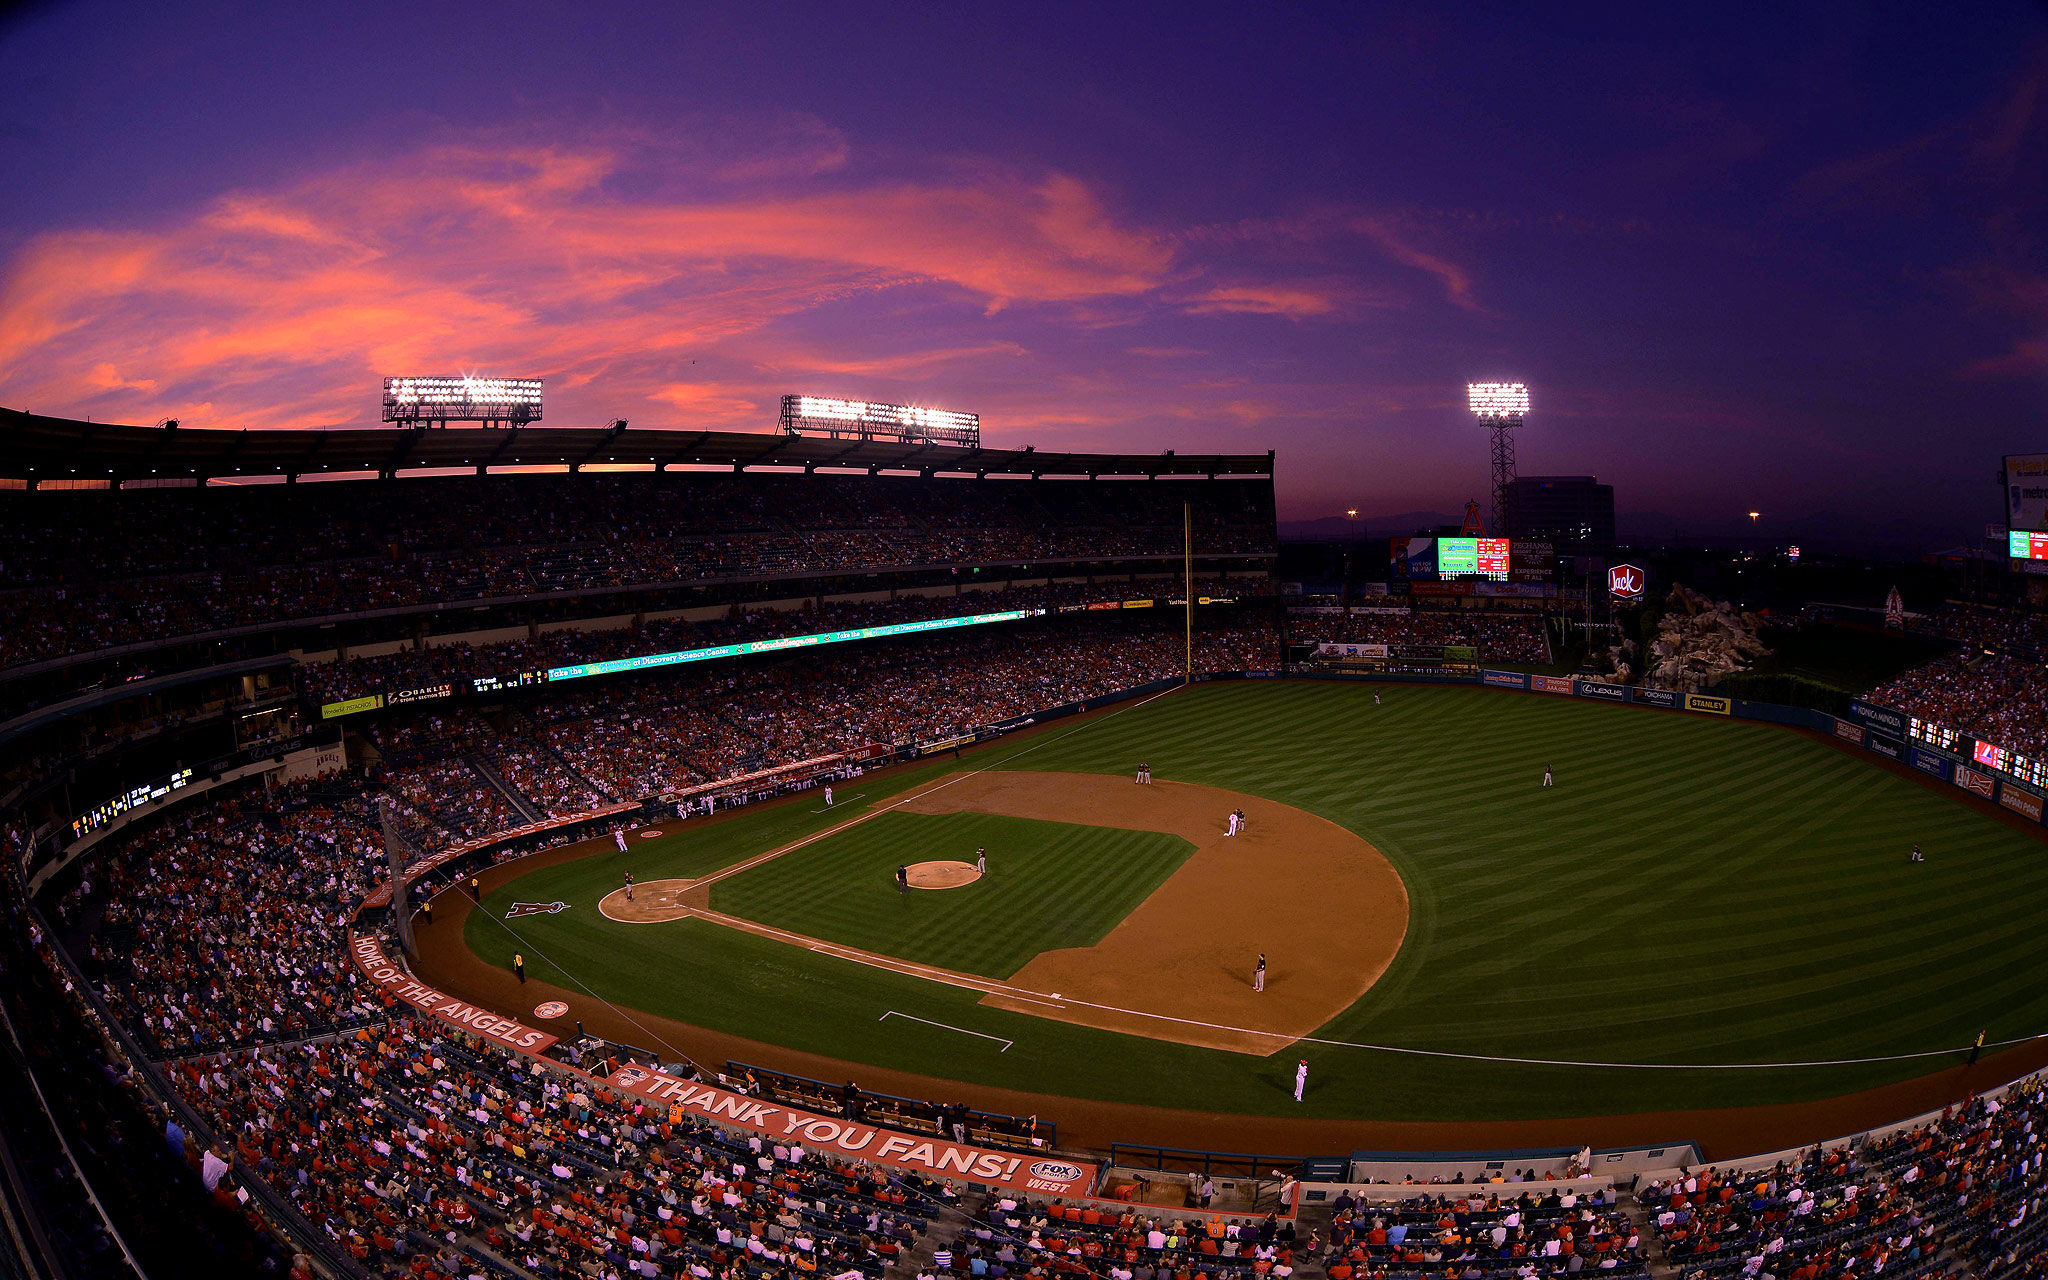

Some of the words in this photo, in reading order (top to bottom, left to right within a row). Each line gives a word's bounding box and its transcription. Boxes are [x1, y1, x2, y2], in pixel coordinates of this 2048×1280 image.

[1513, 542, 1553, 550] PECHANGA
[1611, 568, 1643, 593] Jack
[836, 631, 850, 639] Take
[851, 630, 860, 638] the
[901, 623, 924, 632] Discovery
[925, 621, 942, 629] Science
[943, 619, 959, 627] Center
[549, 669, 568, 679] Take
[571, 667, 583, 676] the
[642, 655, 677, 667] Discovery
[678, 651, 706, 661] Science
[706, 647, 730, 657] Center
[413, 684, 450, 695] OAKLEY
[418, 692, 437, 701] SECTION
[438, 689, 450, 698] 113
[1547, 685, 1569, 693] AAA.com
[1593, 686, 1623, 696] LEXUS
[1644, 691, 1674, 701] YOKOHAMA
[346, 702, 372, 712] PISTACHIOS
[1692, 699, 1723, 710] STANLEY
[1857, 706, 1877, 719] KONICA
[1878, 713, 1901, 727] MINOLTA
[264, 740, 302, 755] LEXUS
[1872, 739, 1897, 757] Thermador
[316, 754, 339, 767] ANGELS
[2001, 793, 2023, 809] SAFARI
[2023, 802, 2040, 818] PARK
[491, 811, 590, 838] WELCOME
[464, 837, 492, 848] TO
[429, 846, 465, 861] THE
[405, 861, 433, 875] BIG
[354, 936, 387, 970] HOME
[372, 968, 406, 984] OF
[397, 981, 445, 1008] THE
[435, 1002, 544, 1048] ANGELS
[645, 1074, 780, 1128] THANK
[783, 1112, 876, 1150] YOU
[876, 1135, 1022, 1182] FANS!
[1039, 1171, 1069, 1179] SPORTS
[1041, 1163, 1071, 1176] FOX
[1026, 1177, 1071, 1193] WEST
